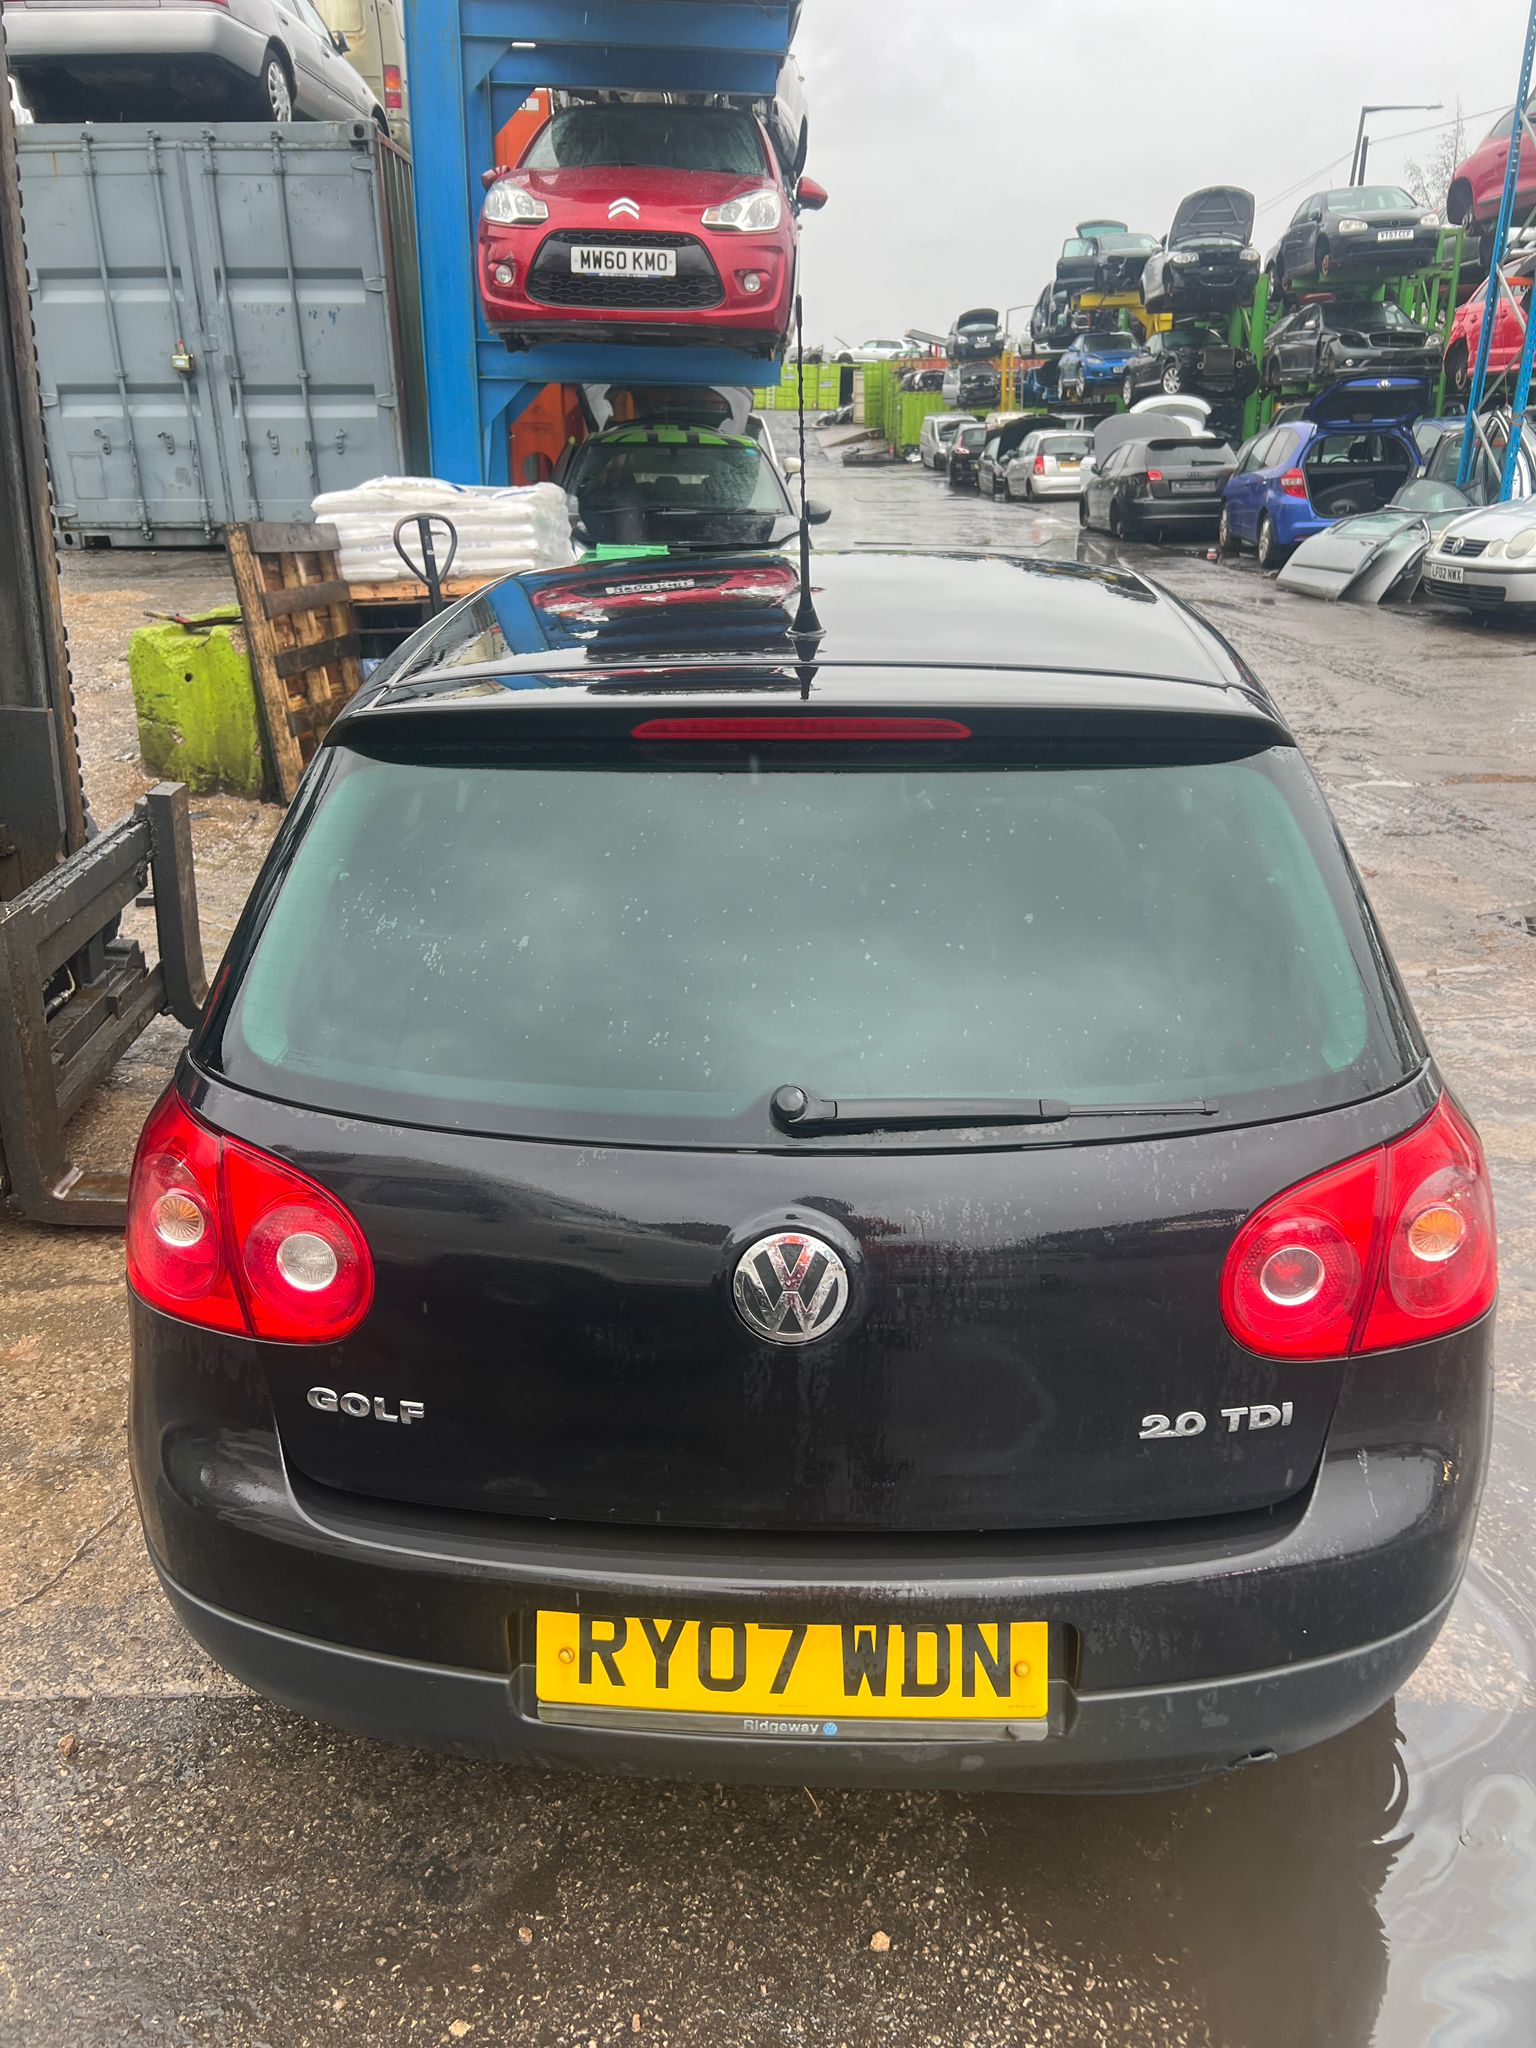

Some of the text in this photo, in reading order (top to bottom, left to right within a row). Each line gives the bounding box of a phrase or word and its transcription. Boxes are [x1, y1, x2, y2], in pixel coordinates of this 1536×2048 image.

[580, 250, 668, 272] MW60 KMO
[306, 1386, 425, 1425] GOLF
[1220, 1401, 1294, 1433] TDI
[578, 1613, 1012, 1698] RY07 WDN
[743, 1720, 819, 1735] Ridgeway
